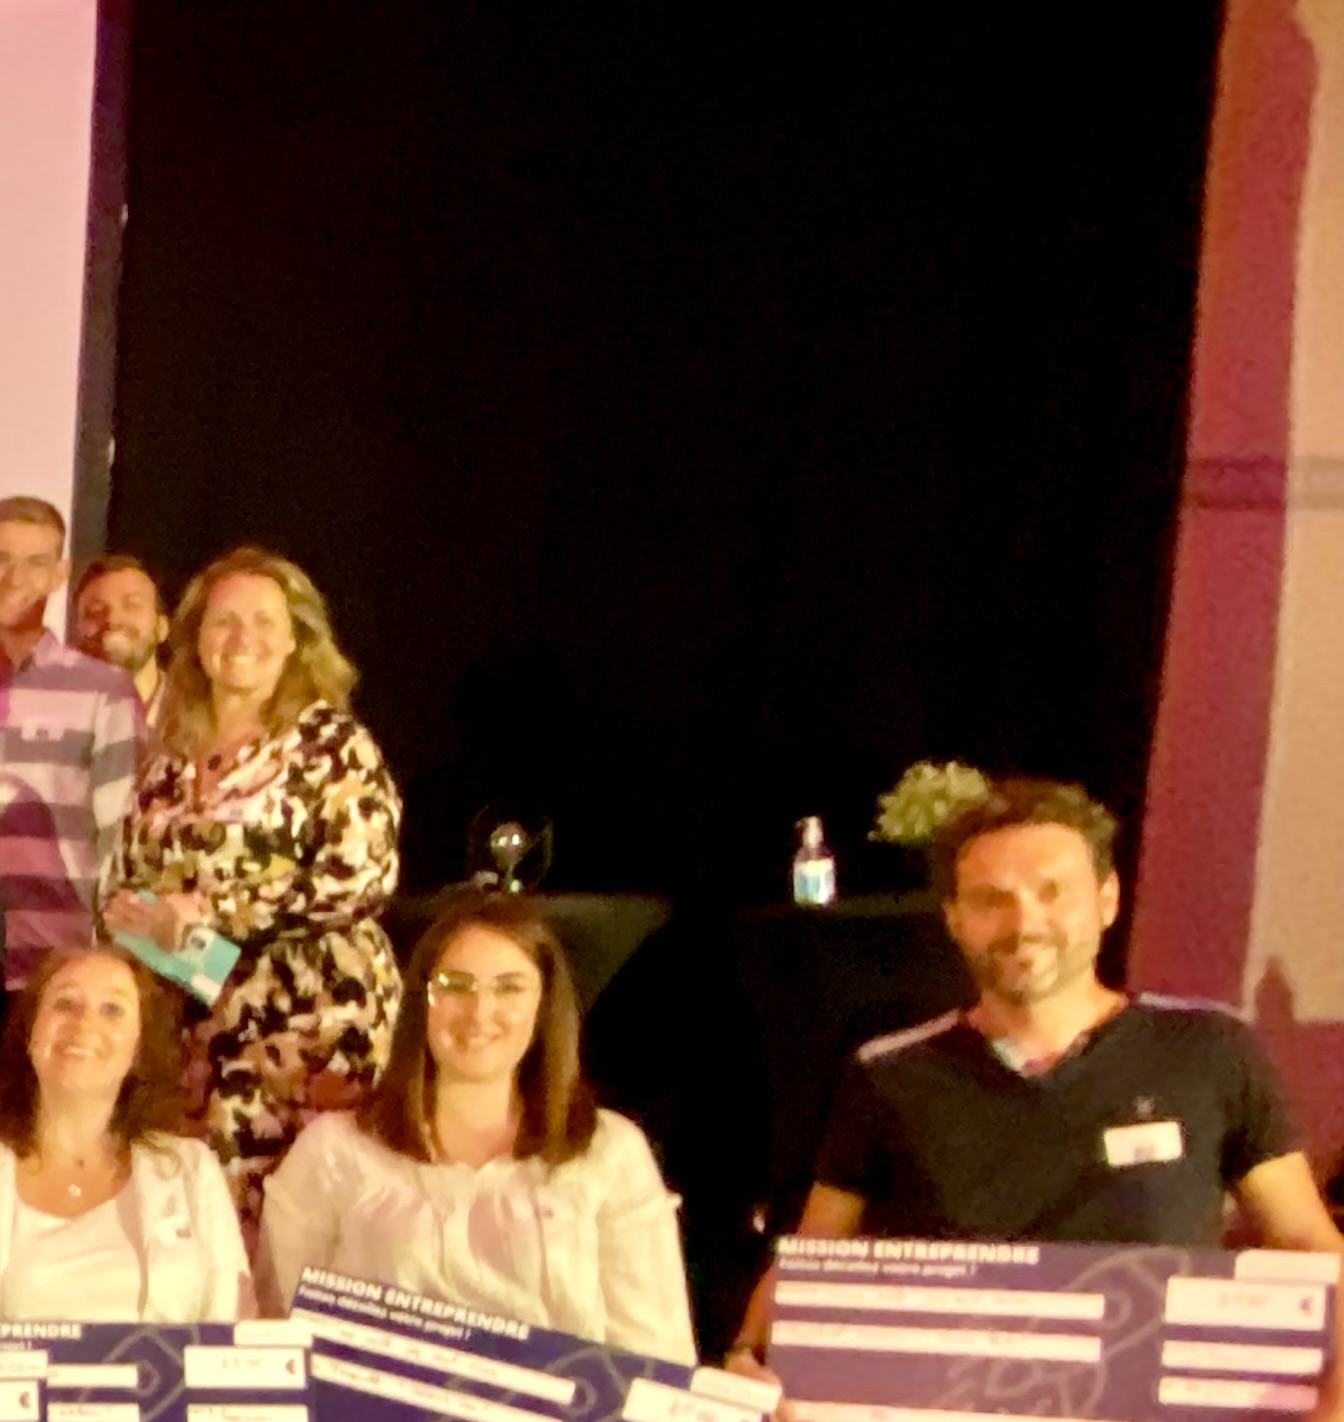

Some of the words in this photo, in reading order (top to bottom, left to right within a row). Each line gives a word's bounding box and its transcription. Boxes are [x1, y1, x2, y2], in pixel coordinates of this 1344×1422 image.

[778, 1237, 869, 1257] MISSION
[873, 1242, 1040, 1264] ENTREPRENDRE
[302, 1266, 382, 1300] MISSION
[385, 1285, 531, 1340] ENTREPRENDRE
